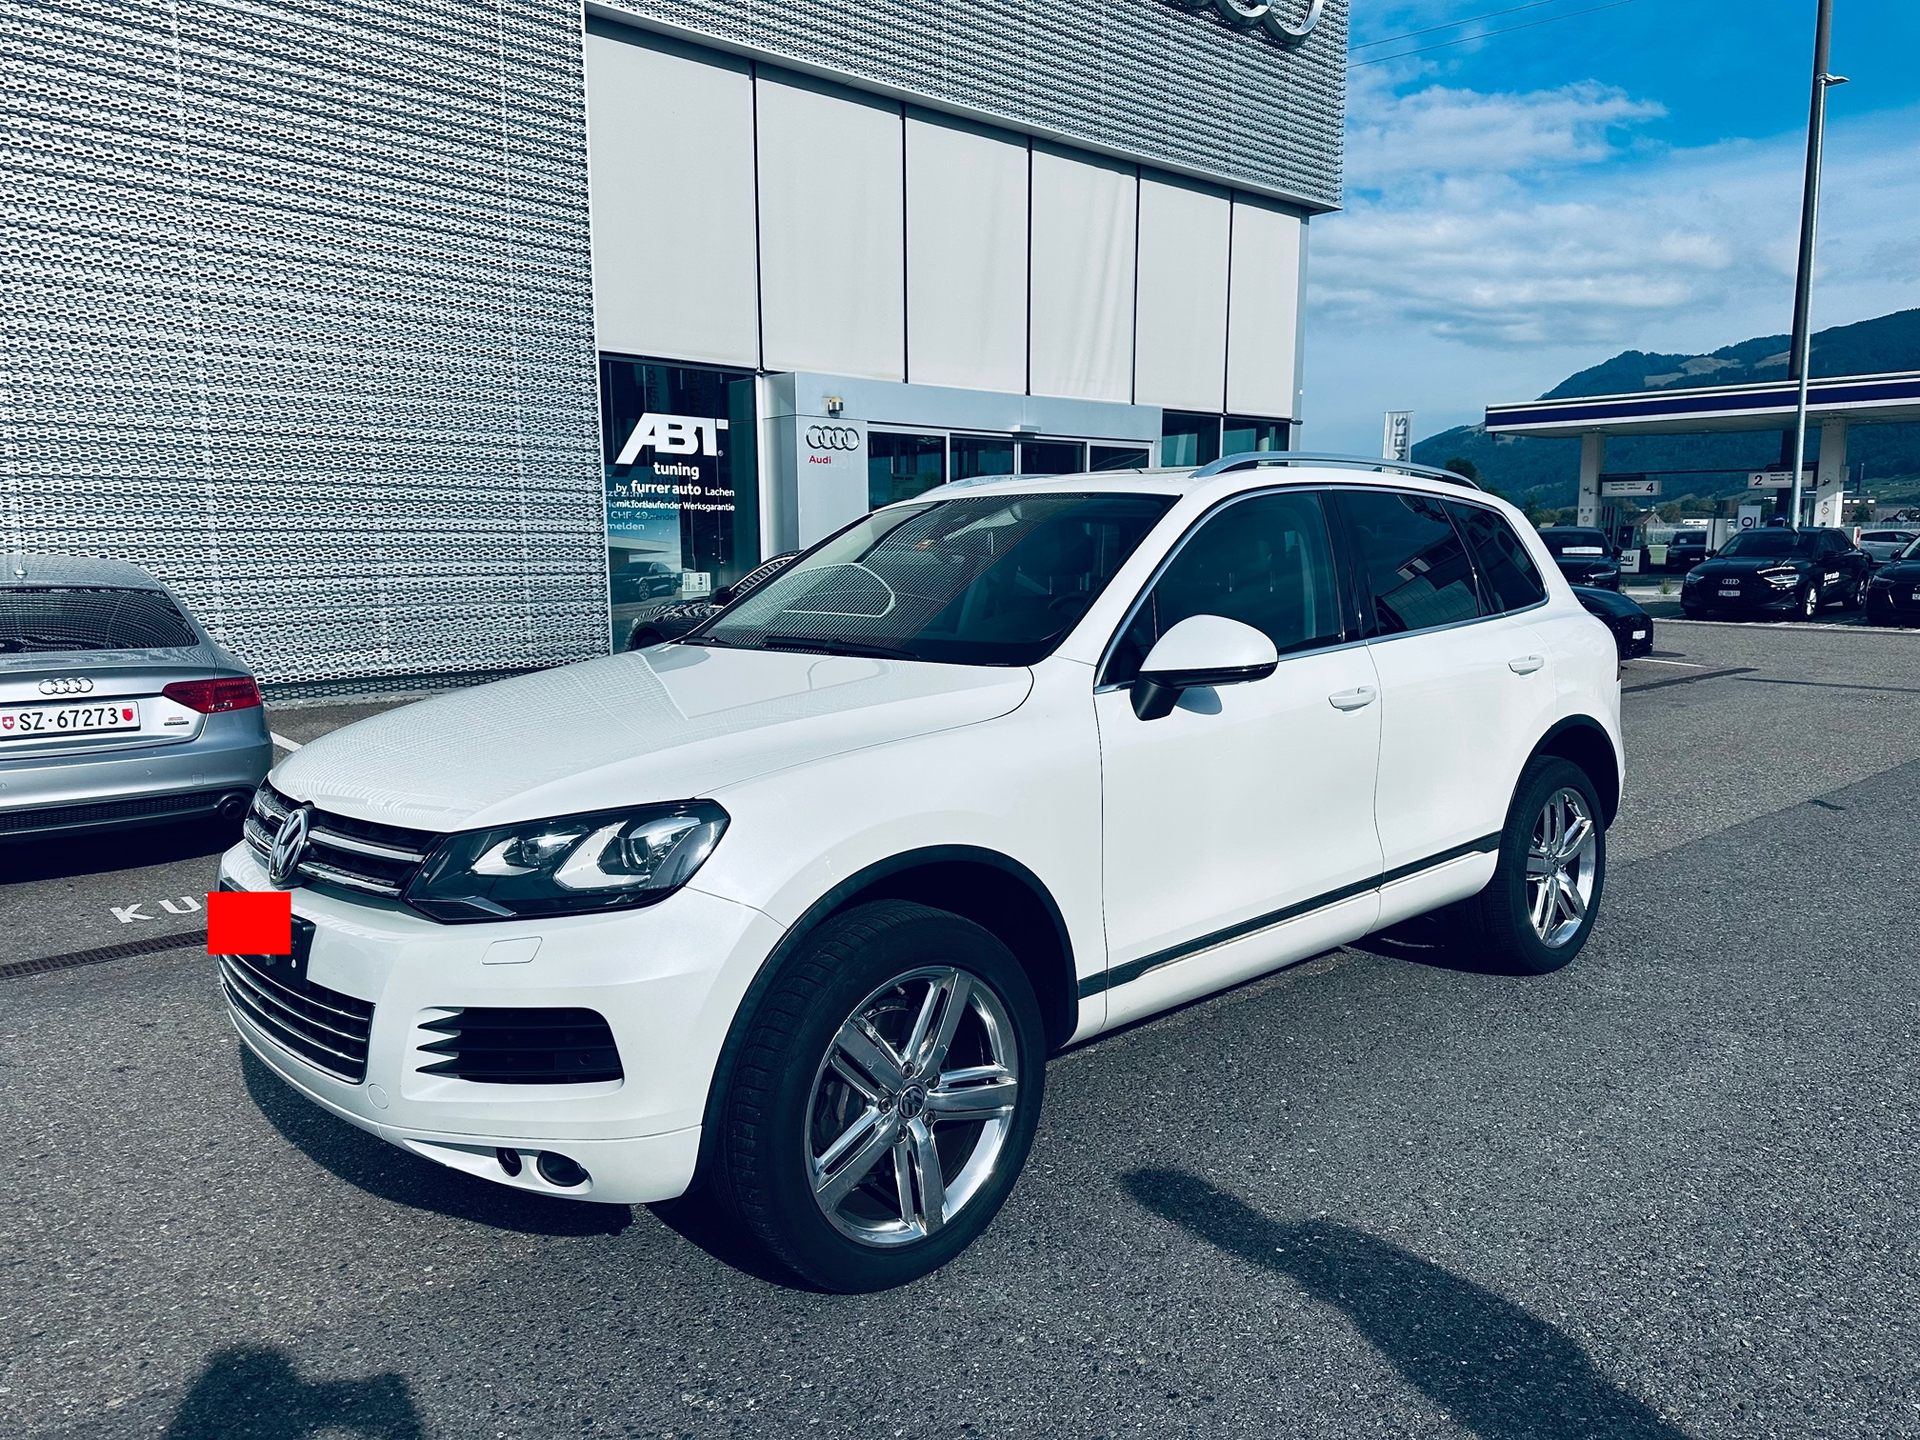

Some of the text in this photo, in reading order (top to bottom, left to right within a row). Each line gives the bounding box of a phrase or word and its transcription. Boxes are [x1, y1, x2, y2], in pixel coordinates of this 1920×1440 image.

[809, 455, 831, 464] Audi
[653, 462, 700, 480] tuning
[1754, 475, 1762, 486] 2
[615, 479, 735, 497] by furrer auto Lachen
[1646, 483, 1654, 493] 4
[682, 502, 735, 513] Werksgarantie
[110, 892, 208, 924] KU
